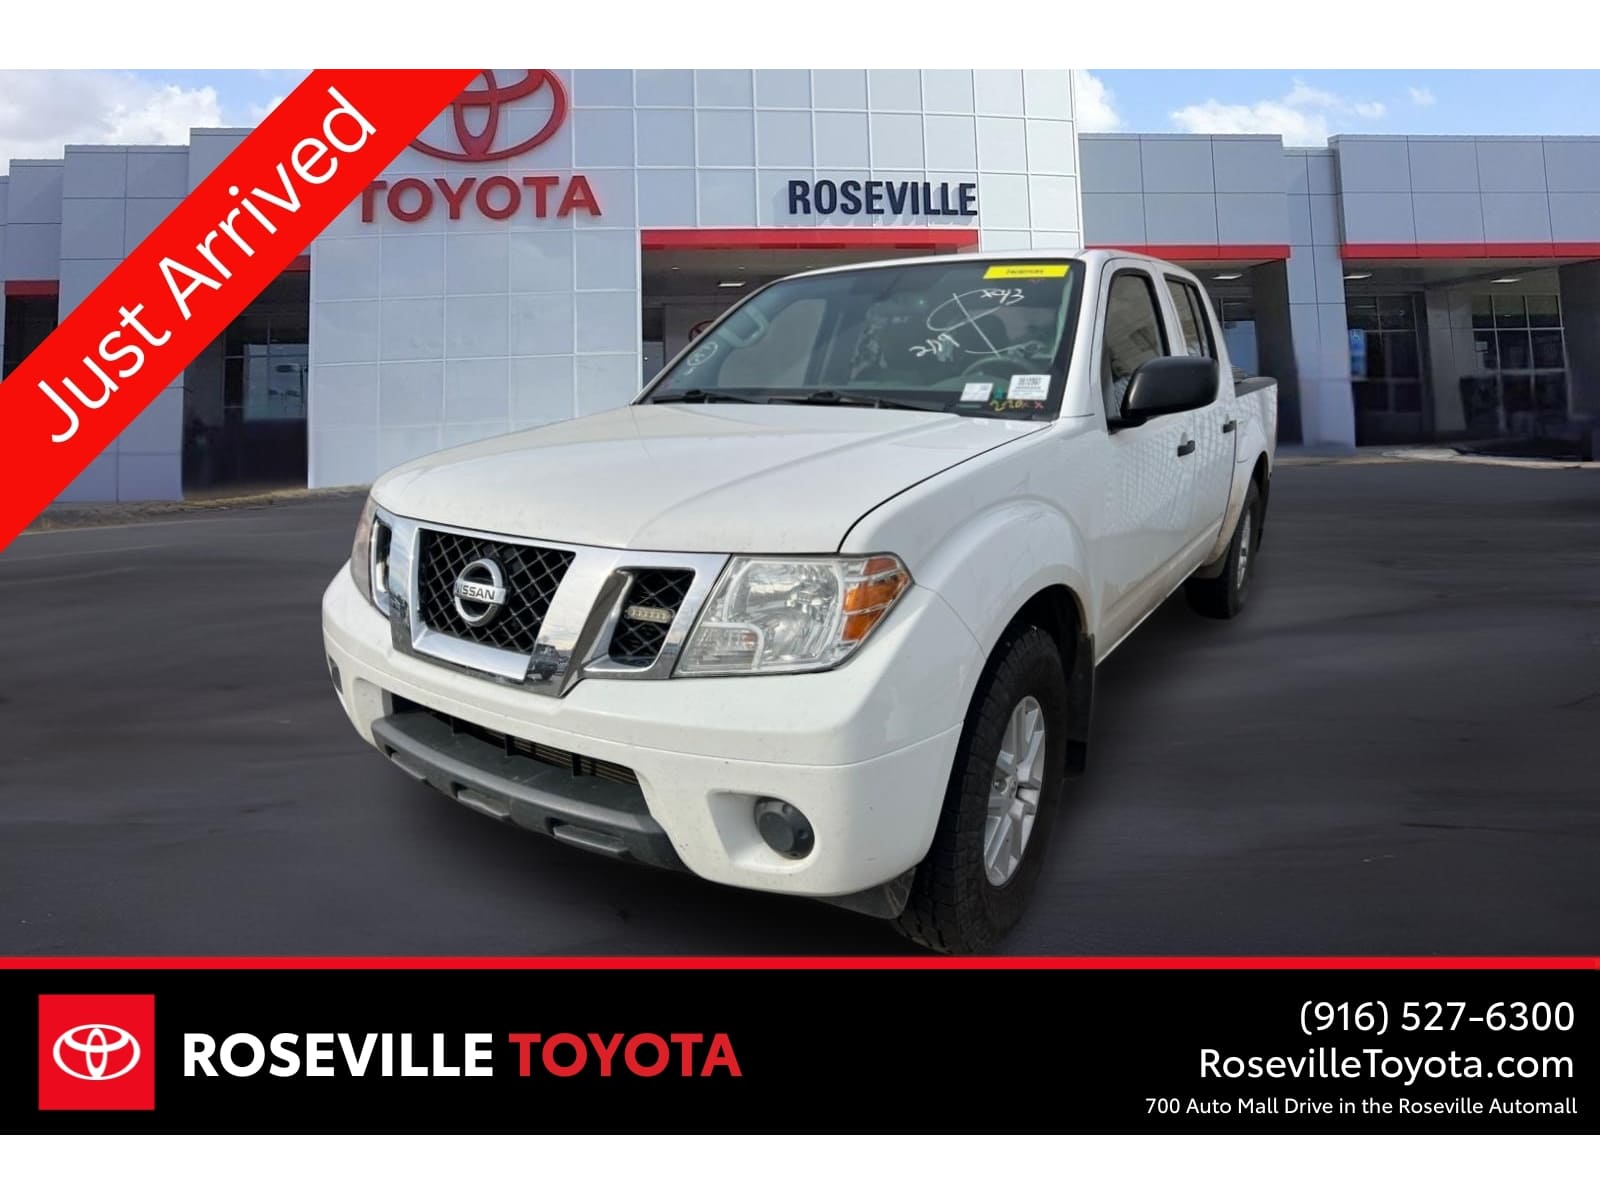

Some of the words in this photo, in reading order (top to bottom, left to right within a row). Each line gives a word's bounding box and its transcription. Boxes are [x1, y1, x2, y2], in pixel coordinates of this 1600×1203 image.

[361, 175, 602, 223] TOYOTA
[788, 180, 978, 216] ROSEVILLE
[456, 583, 496, 601] NISSAN
